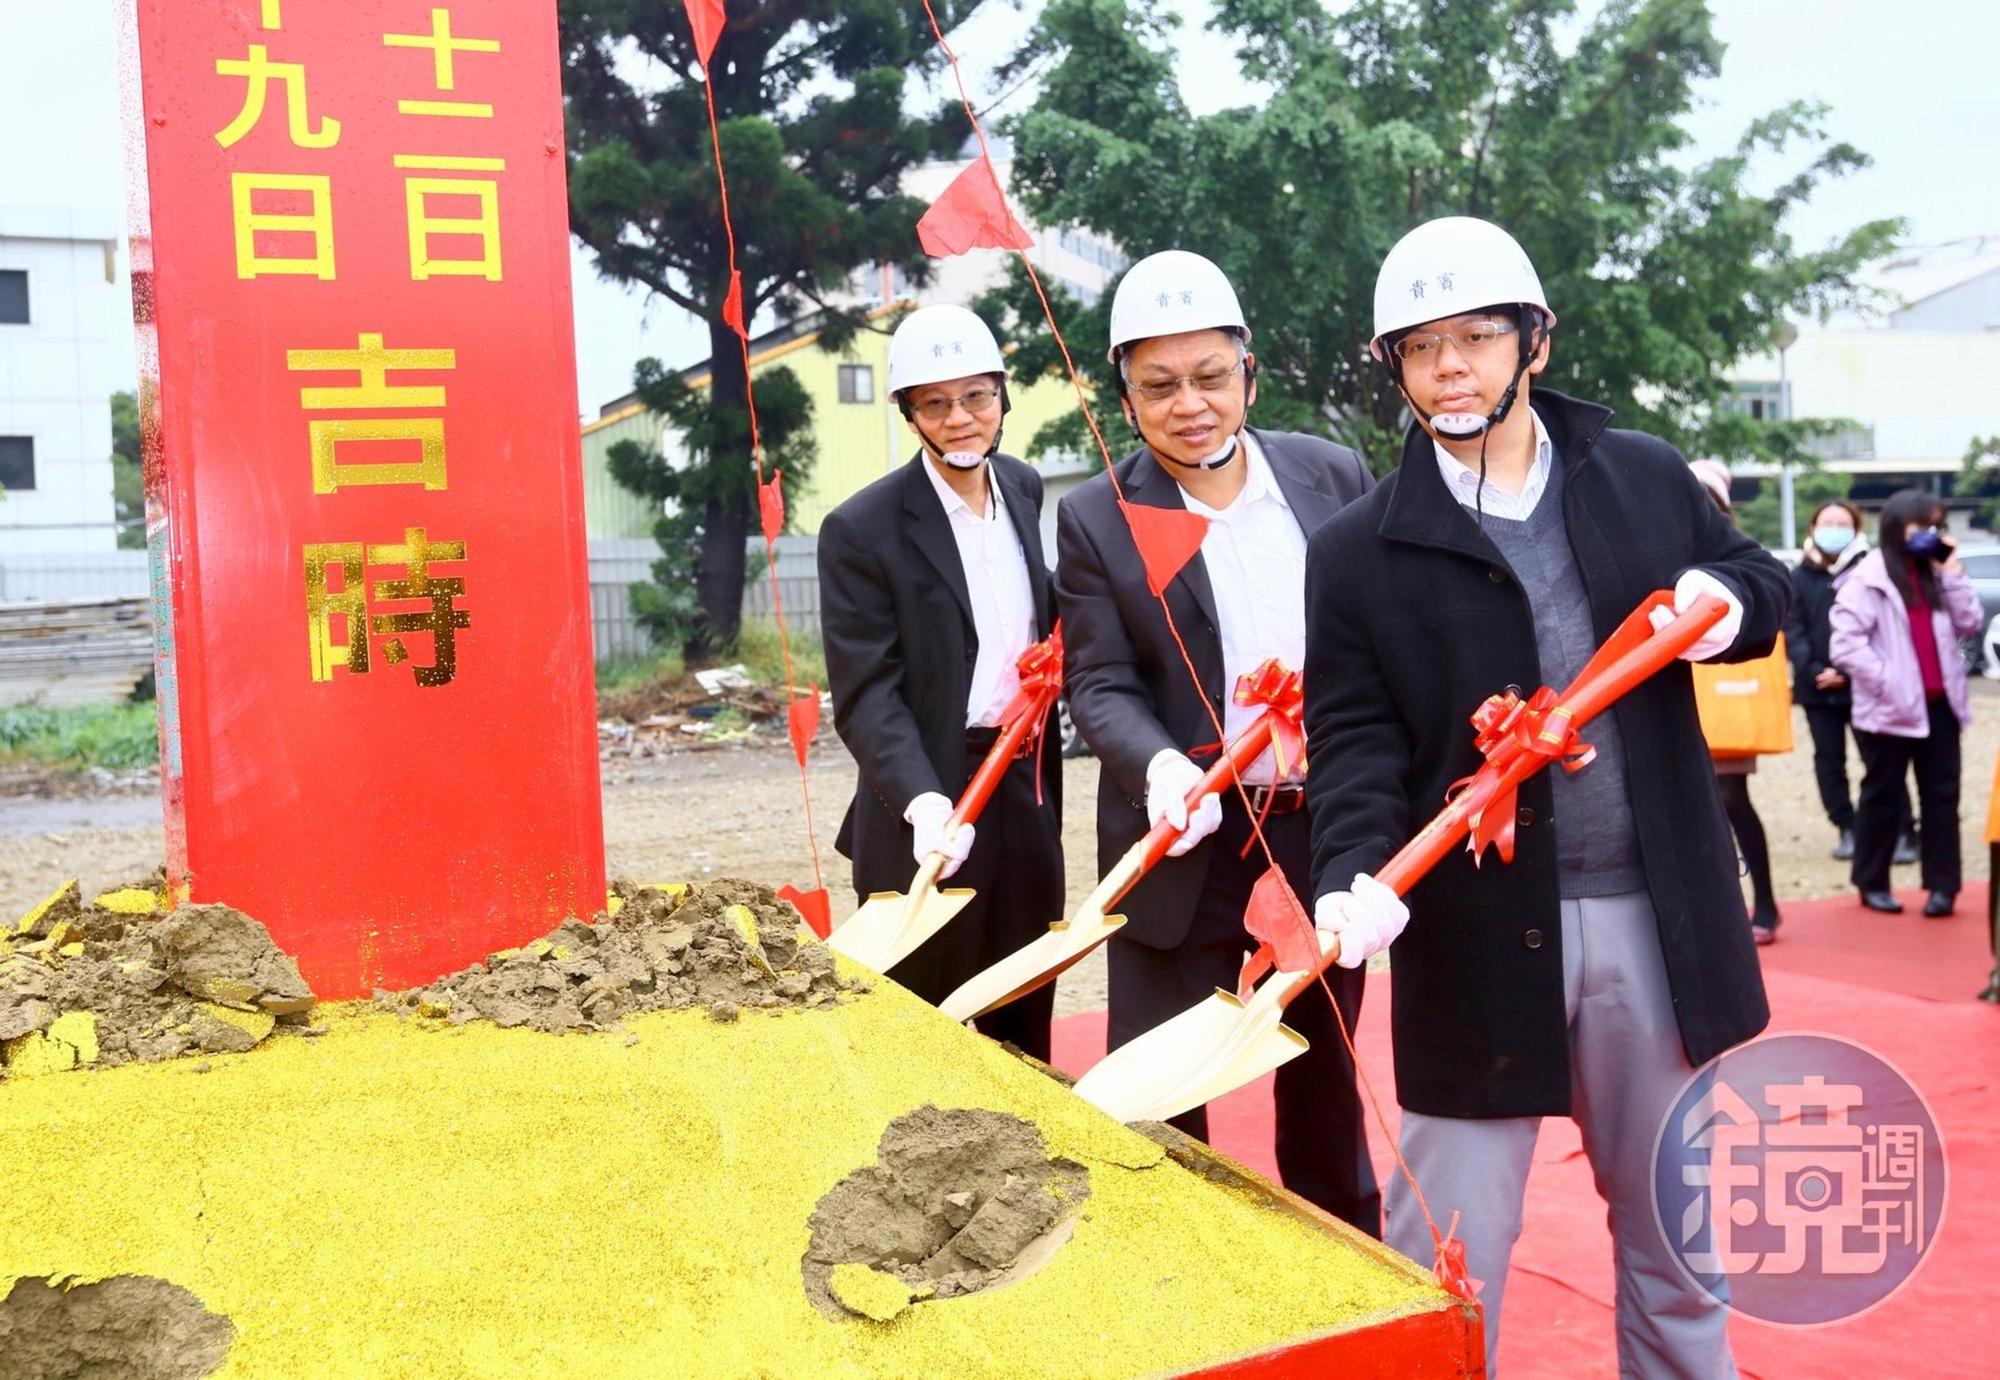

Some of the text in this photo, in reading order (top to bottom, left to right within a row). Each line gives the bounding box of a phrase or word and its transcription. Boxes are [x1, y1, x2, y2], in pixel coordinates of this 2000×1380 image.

[383, 8, 505, 281] 十二日
[1409, 271, 1456, 300] 貴賓
[286, 332, 471, 688] 吉時
